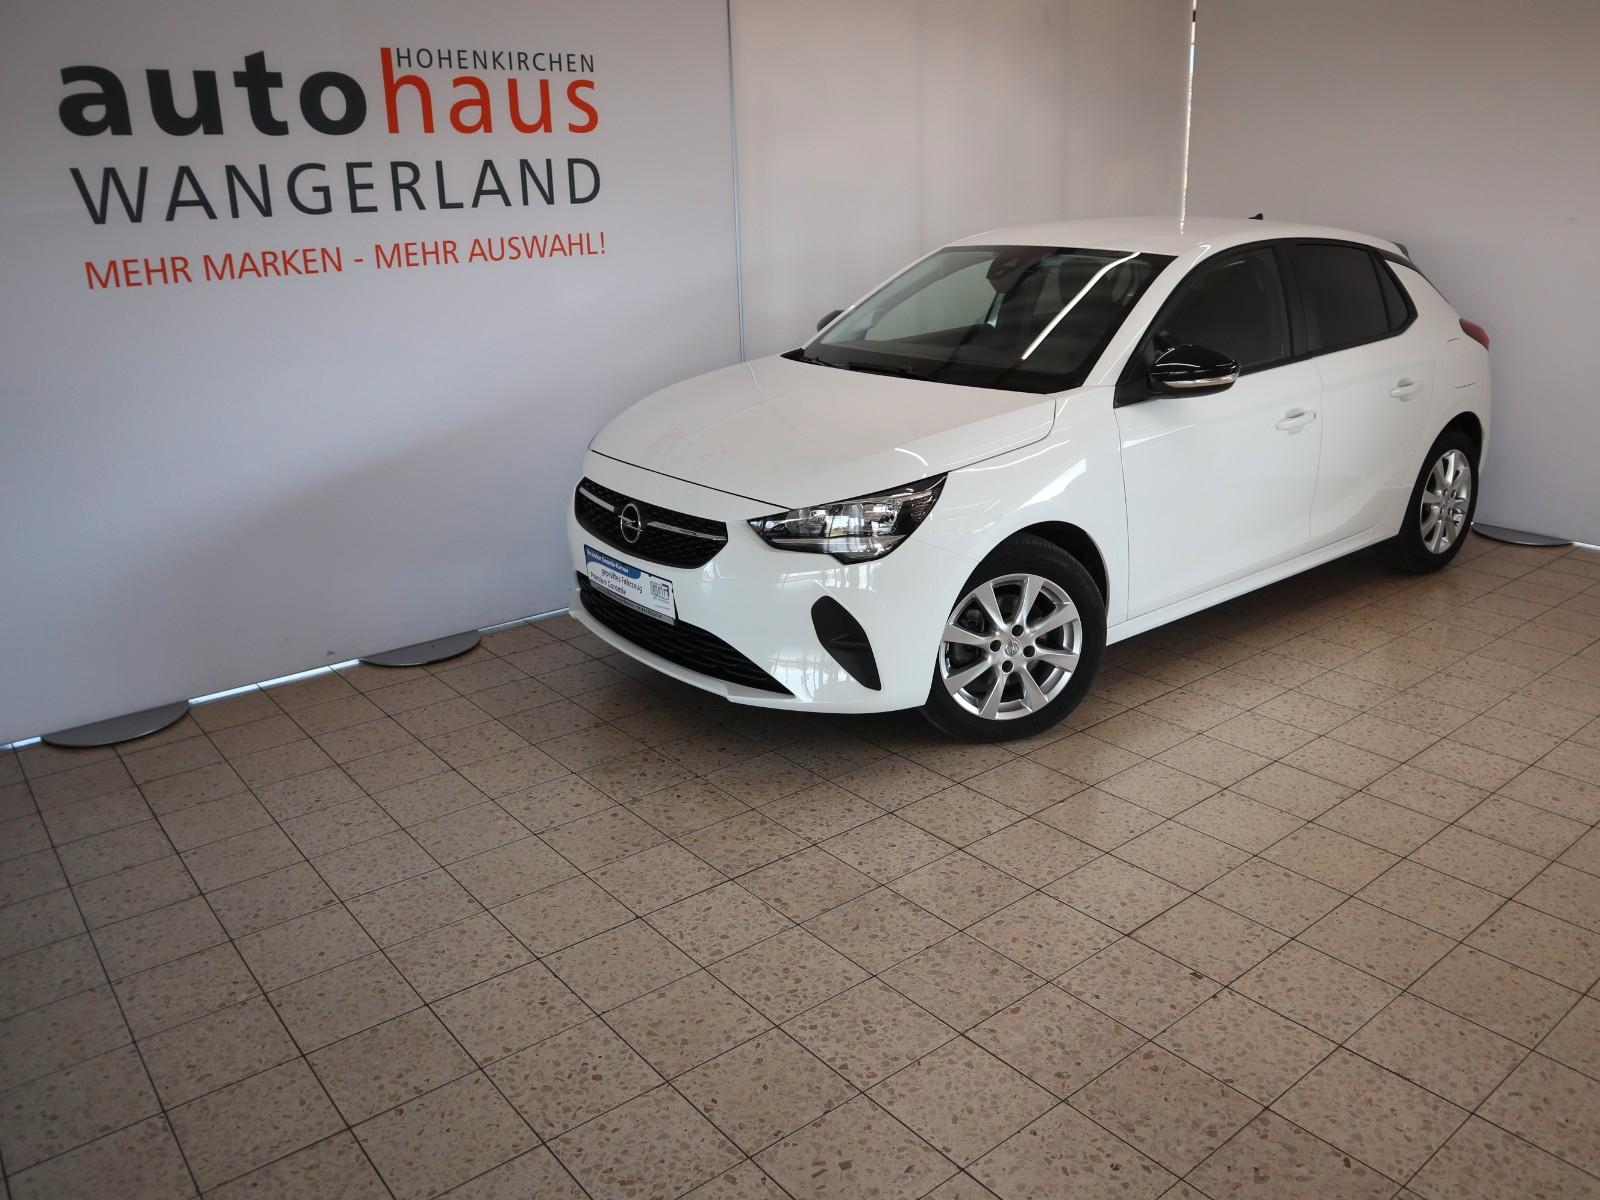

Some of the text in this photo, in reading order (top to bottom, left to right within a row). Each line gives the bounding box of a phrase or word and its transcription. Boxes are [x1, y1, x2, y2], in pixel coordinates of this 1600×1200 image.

[396, 47, 594, 73] HOHENKIRCHEN
[58, 47, 599, 137] autohaus
[69, 157, 601, 225] WANGERLAND
[84, 255, 193, 290] MEHR
[202, 246, 343, 282] MARKEN
[374, 239, 460, 270] MEHR
[468, 231, 606, 264] AUSWAHL!
[590, 570, 608, 587] Premium
[620, 576, 643, 594] Fahrzeug
